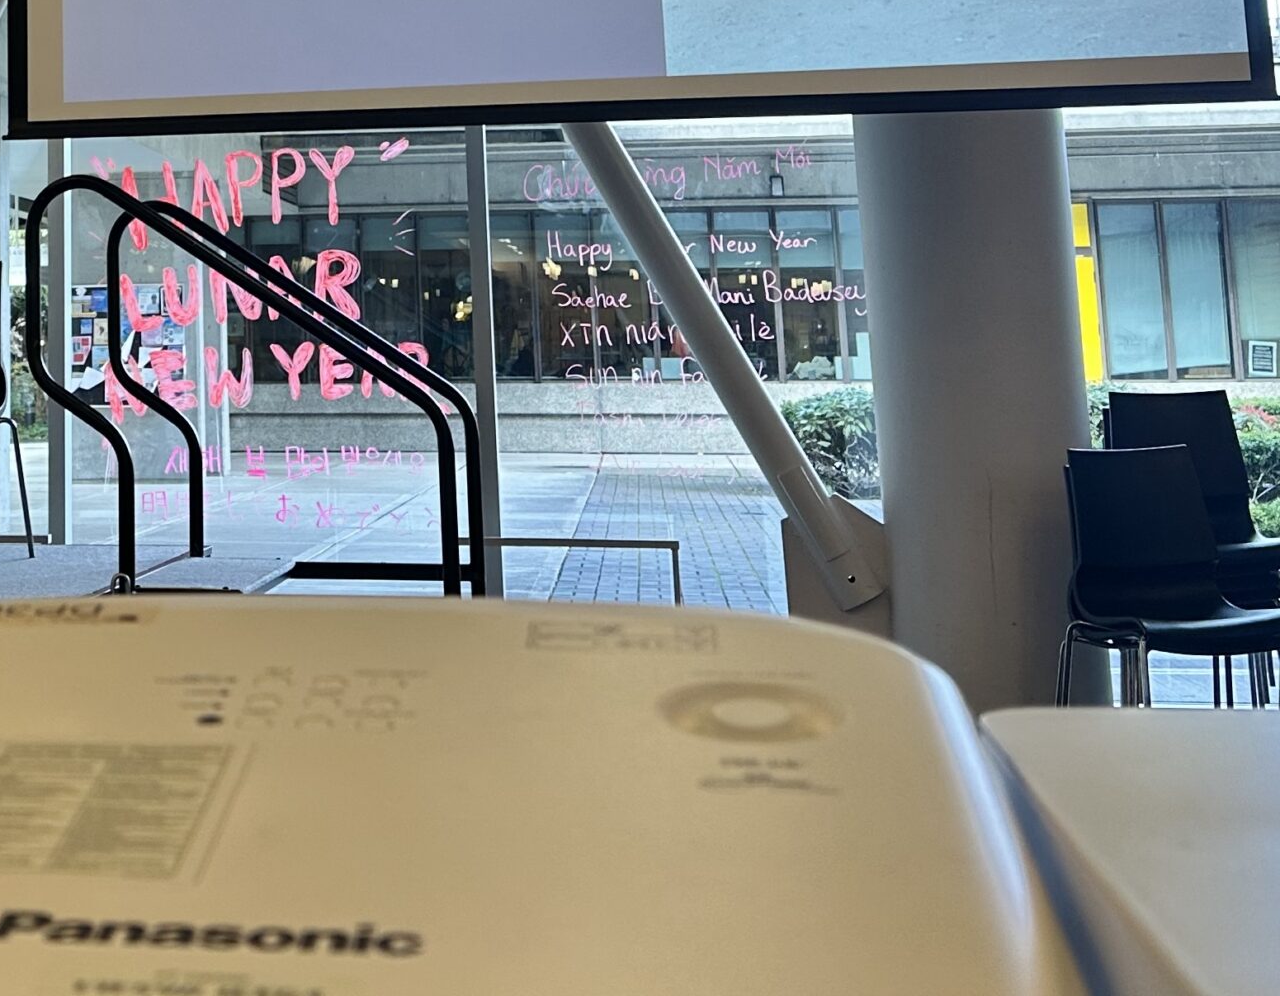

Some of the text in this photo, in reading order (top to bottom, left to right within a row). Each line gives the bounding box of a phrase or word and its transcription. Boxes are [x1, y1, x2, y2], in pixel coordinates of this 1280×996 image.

[120, 144, 356, 252] HAPPY
[546, 229, 614, 272] Happy
[709, 233, 758, 254] New
[769, 229, 817, 252] Year
[104, 346, 253, 425] NEW
